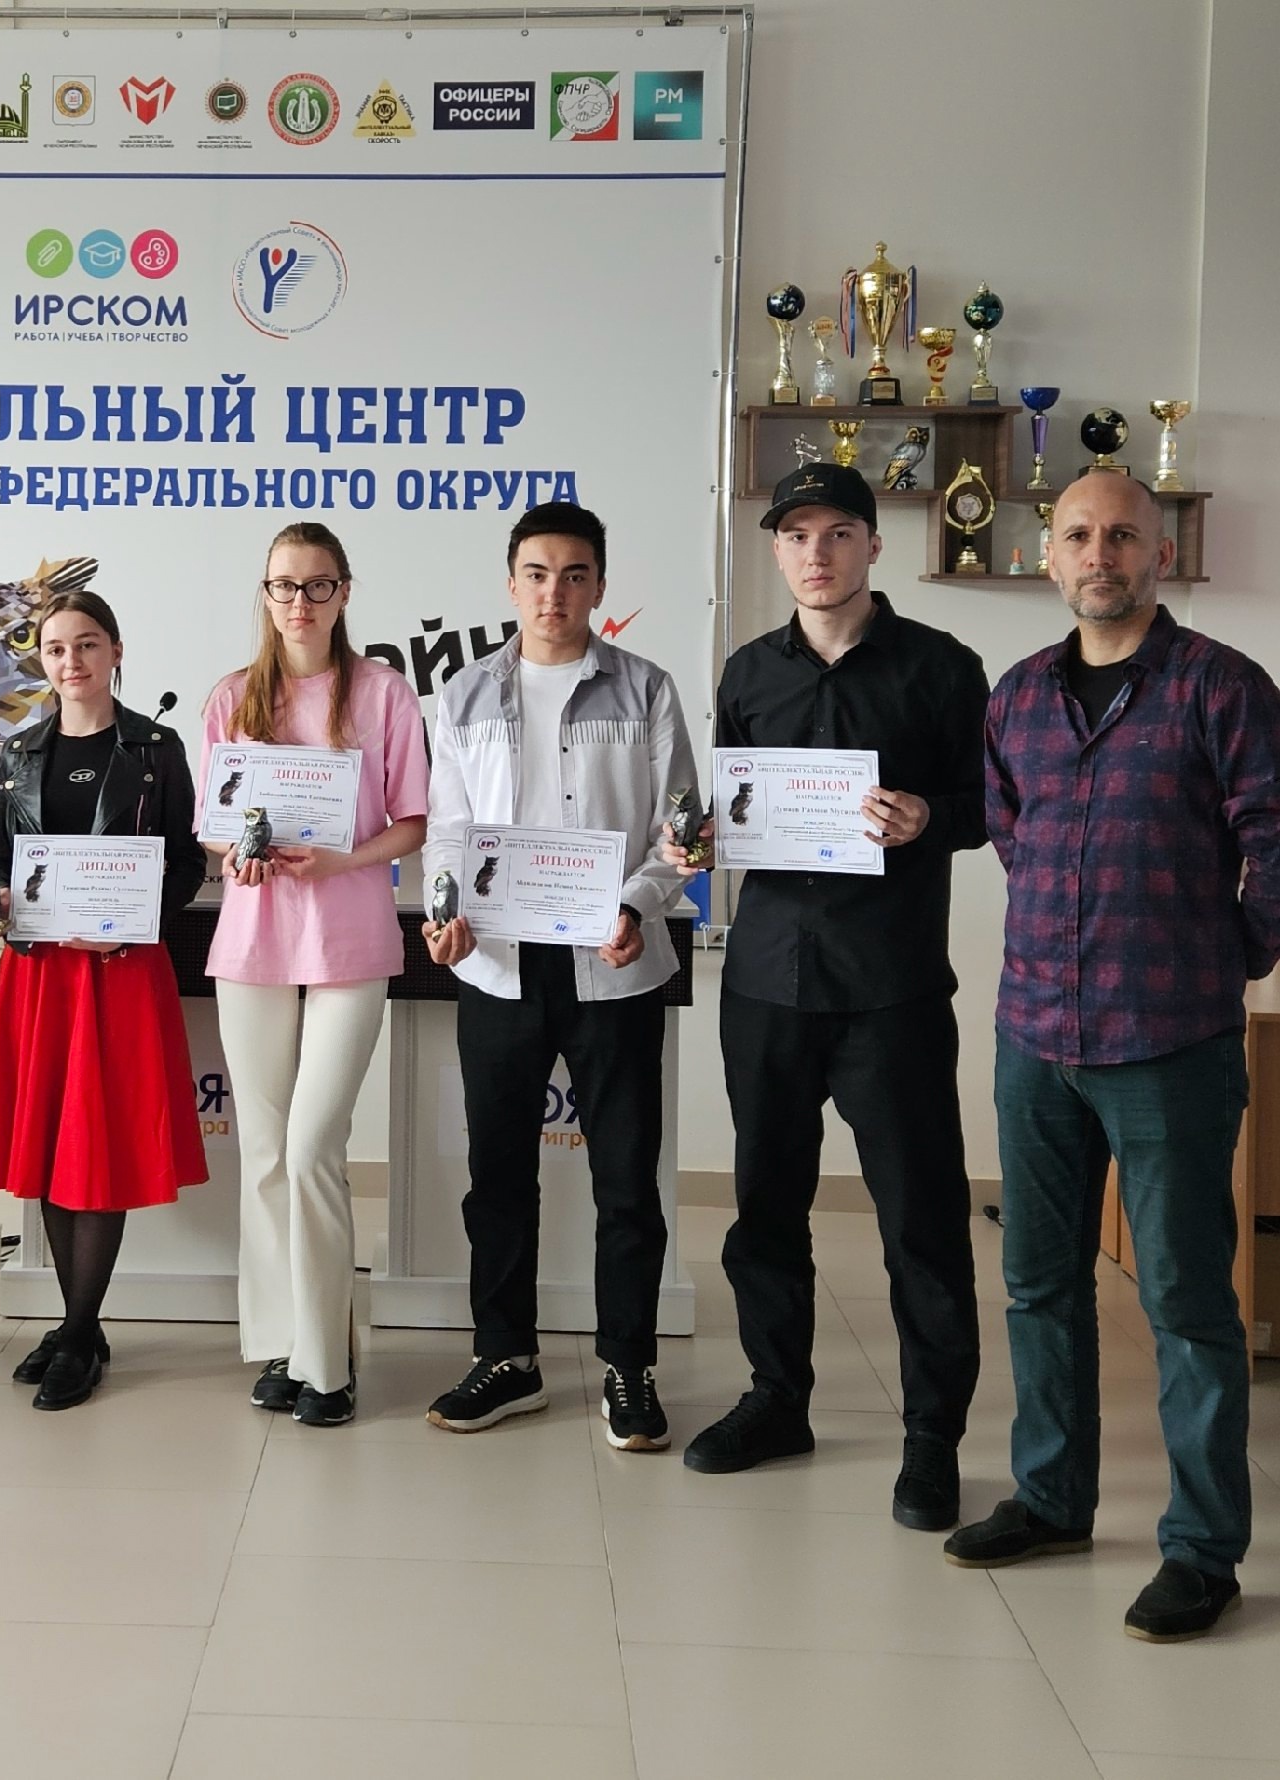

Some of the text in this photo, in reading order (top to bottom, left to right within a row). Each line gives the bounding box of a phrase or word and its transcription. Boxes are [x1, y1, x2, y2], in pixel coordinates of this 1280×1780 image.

[440, 87, 530, 104] ОФИЦЕРЫ
[554, 84, 591, 95] ФПЧР
[449, 108, 521, 121] РОССИИ
[15, 294, 188, 327] ИРСКОМ
[14, 332, 189, 342] РАБОТА УЧЕБА ТВОРЧЕСТВО
[285, 386, 526, 453] ЦЕНТР
[396, 468, 581, 511] ОКРУГА
[272, 768, 332, 782] ДИПЛОМ
[785, 778, 850, 792] ДИПЛОМ
[75, 861, 137, 873] ДИПЛОМ
[530, 854, 595, 869] ДИПЛОМ
